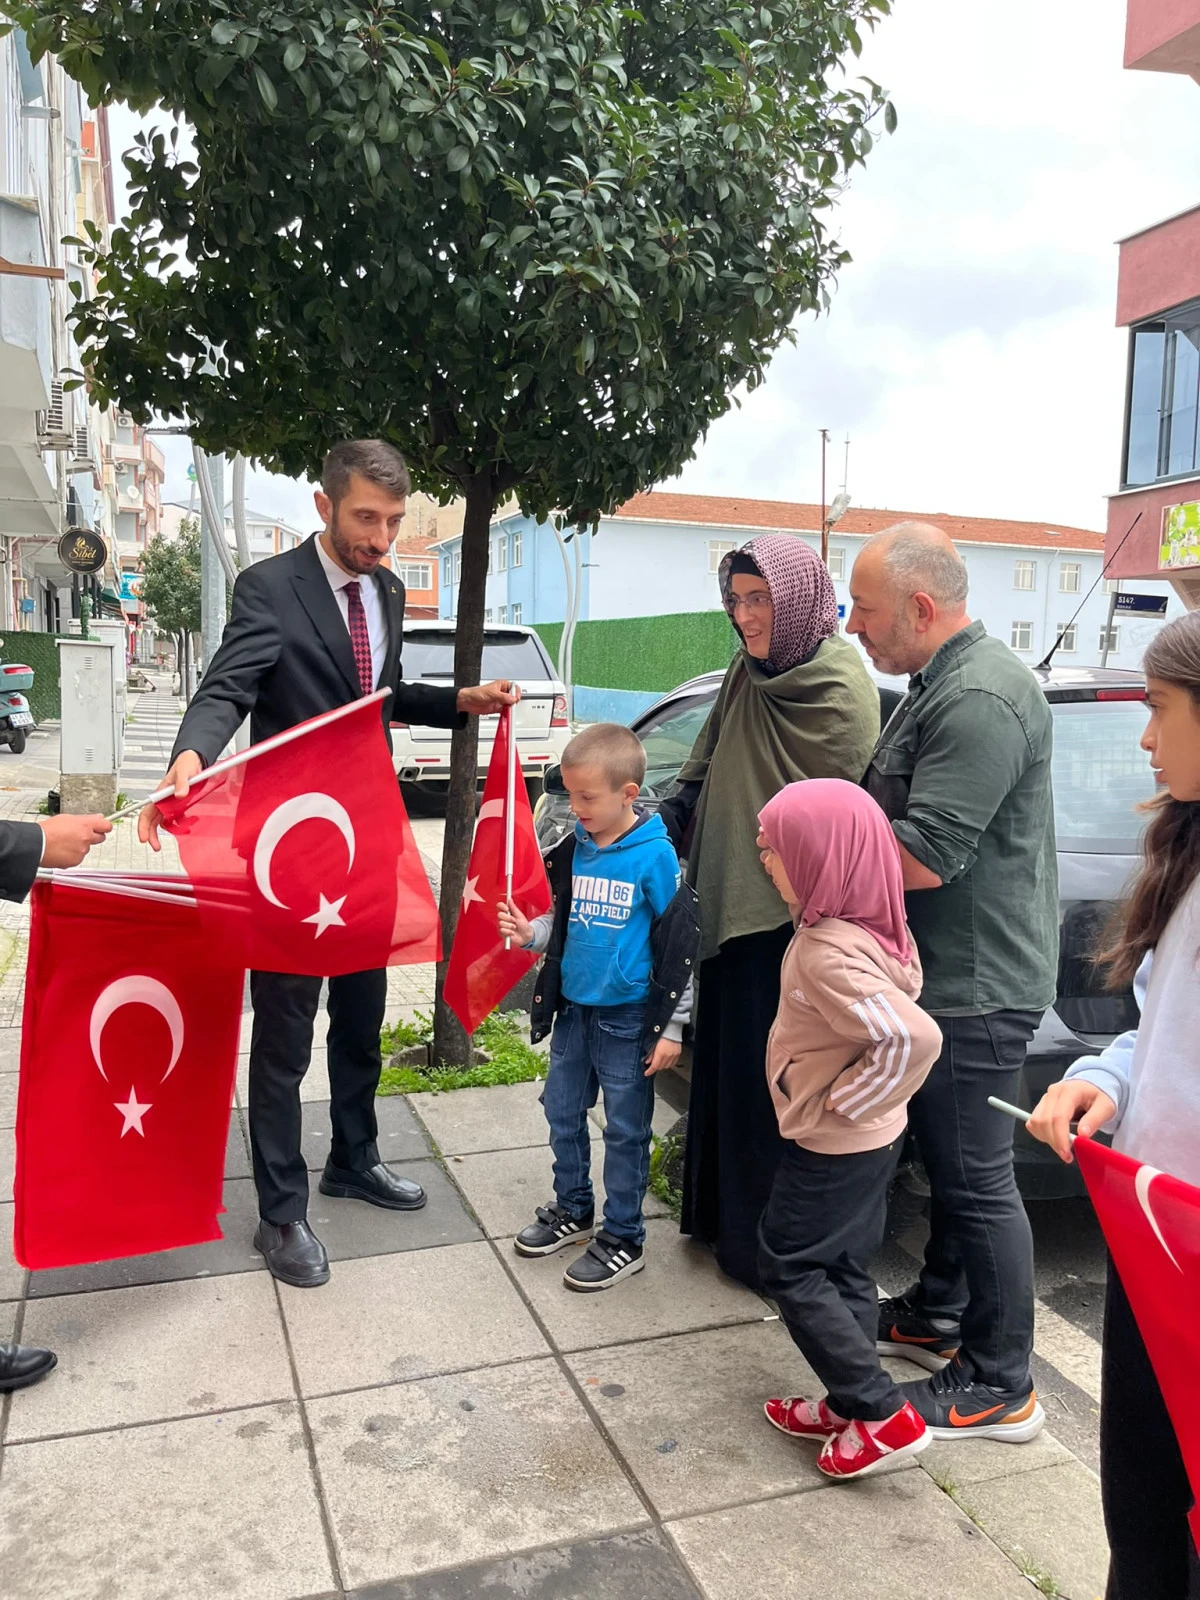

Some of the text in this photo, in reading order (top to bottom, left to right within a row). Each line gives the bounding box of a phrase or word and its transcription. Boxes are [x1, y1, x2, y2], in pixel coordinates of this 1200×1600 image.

[68, 547, 97, 559] Sibel
[613, 884, 630, 902] 86
[579, 901, 601, 917] AND
[601, 904, 631, 921] FIELD
